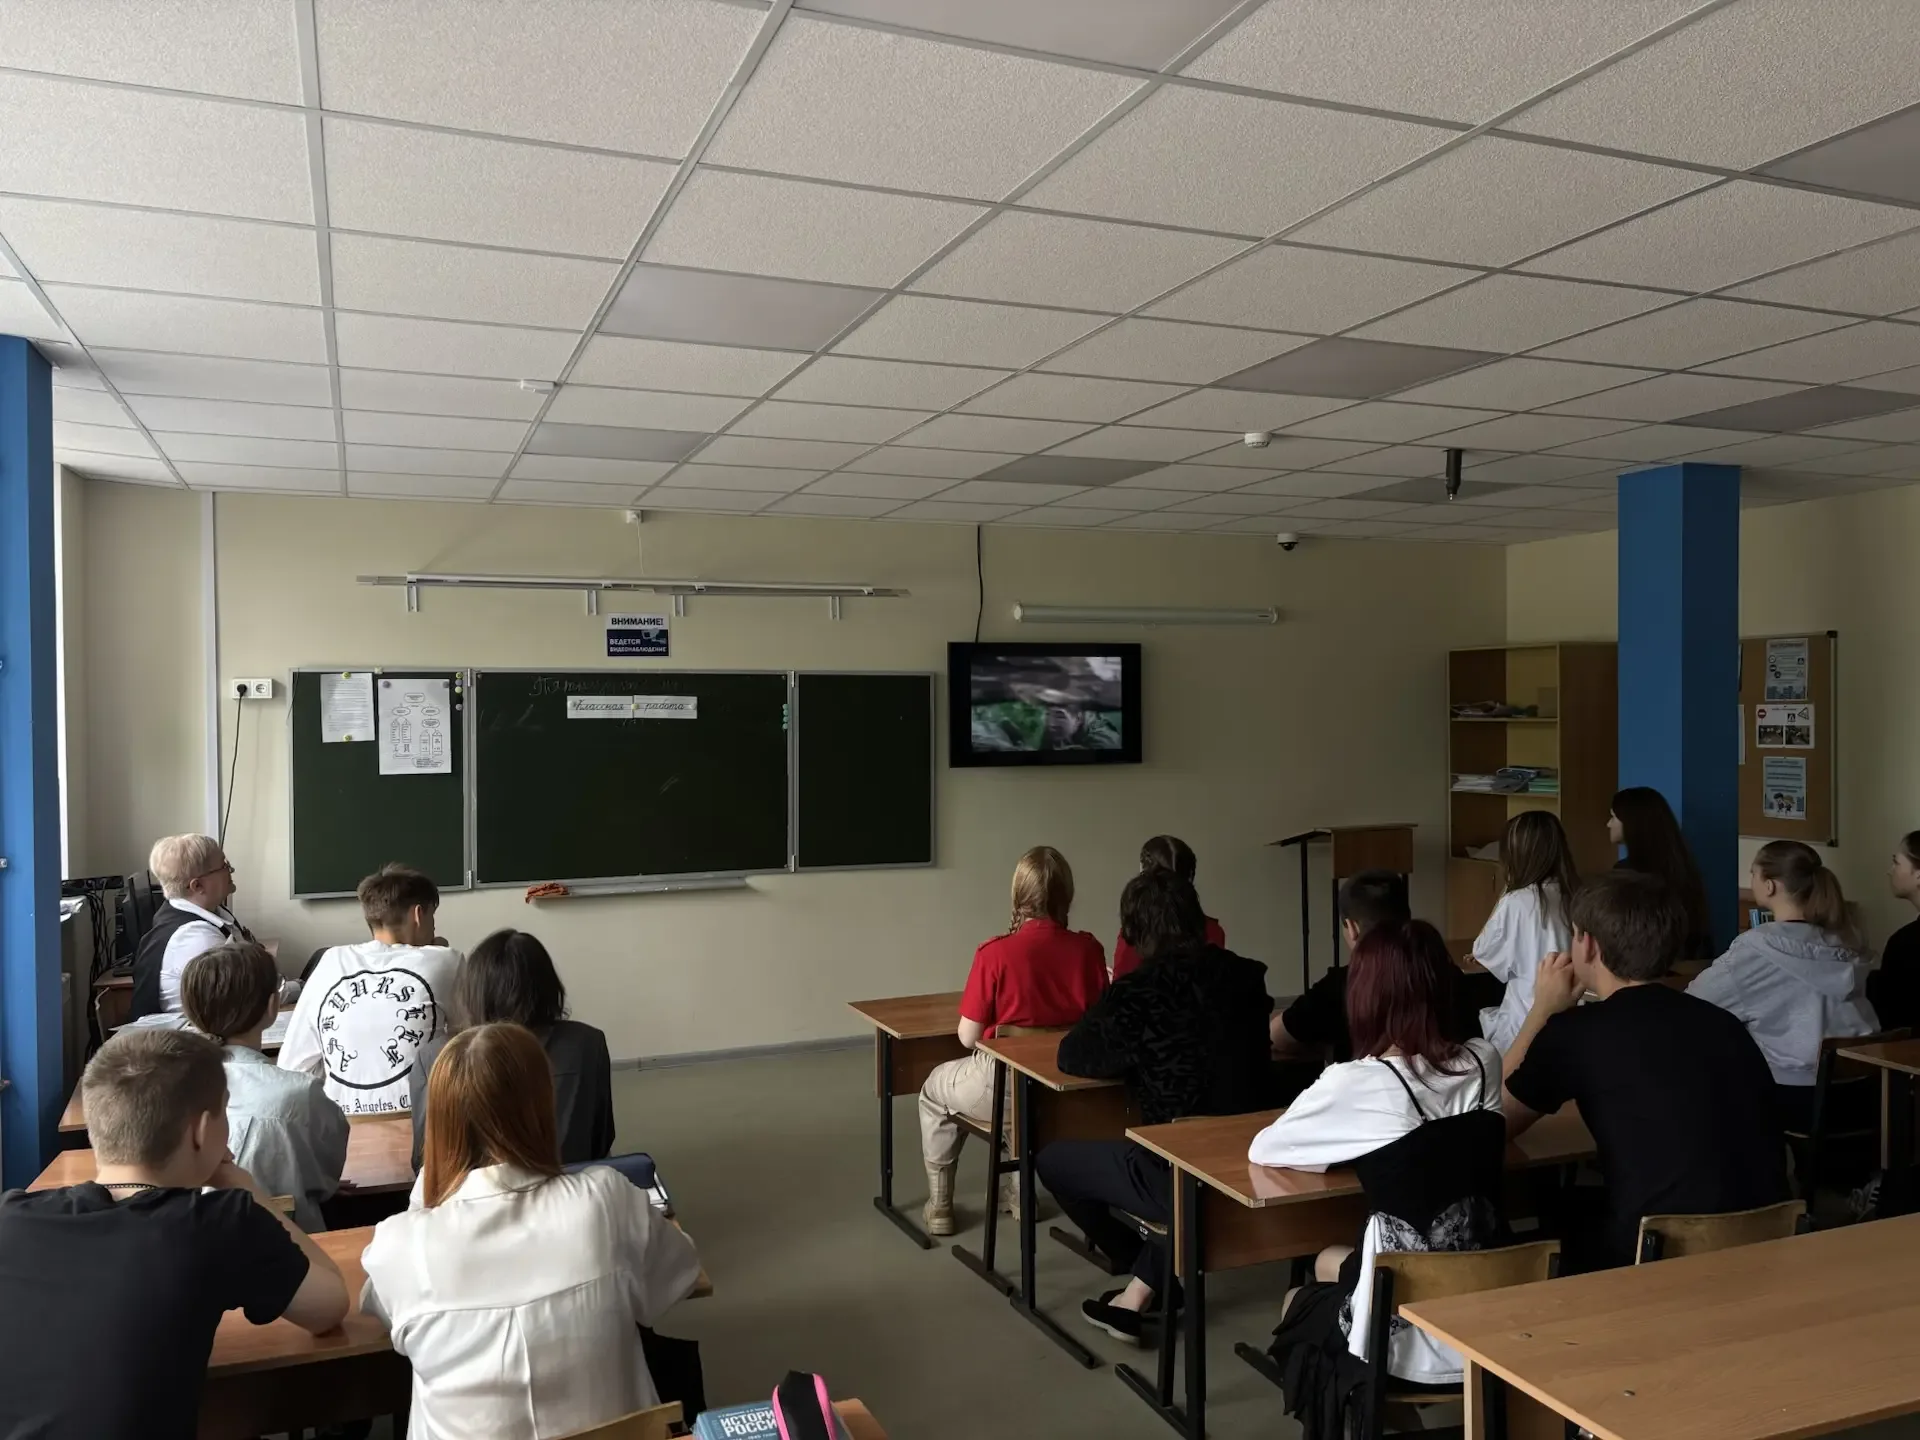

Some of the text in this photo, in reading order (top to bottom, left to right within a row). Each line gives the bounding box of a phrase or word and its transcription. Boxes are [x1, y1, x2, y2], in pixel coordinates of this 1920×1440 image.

[611, 617, 664, 626] ВНИМАНИЕ!
[610, 638, 641, 646] ВЕДЕТСЯ
[573, 699, 685, 713] Классная работа
[354, 1097, 398, 1114] Angeles,
[720, 1409, 776, 1428] ИСТОРИ
[723, 1418, 778, 1438] РОССИ
